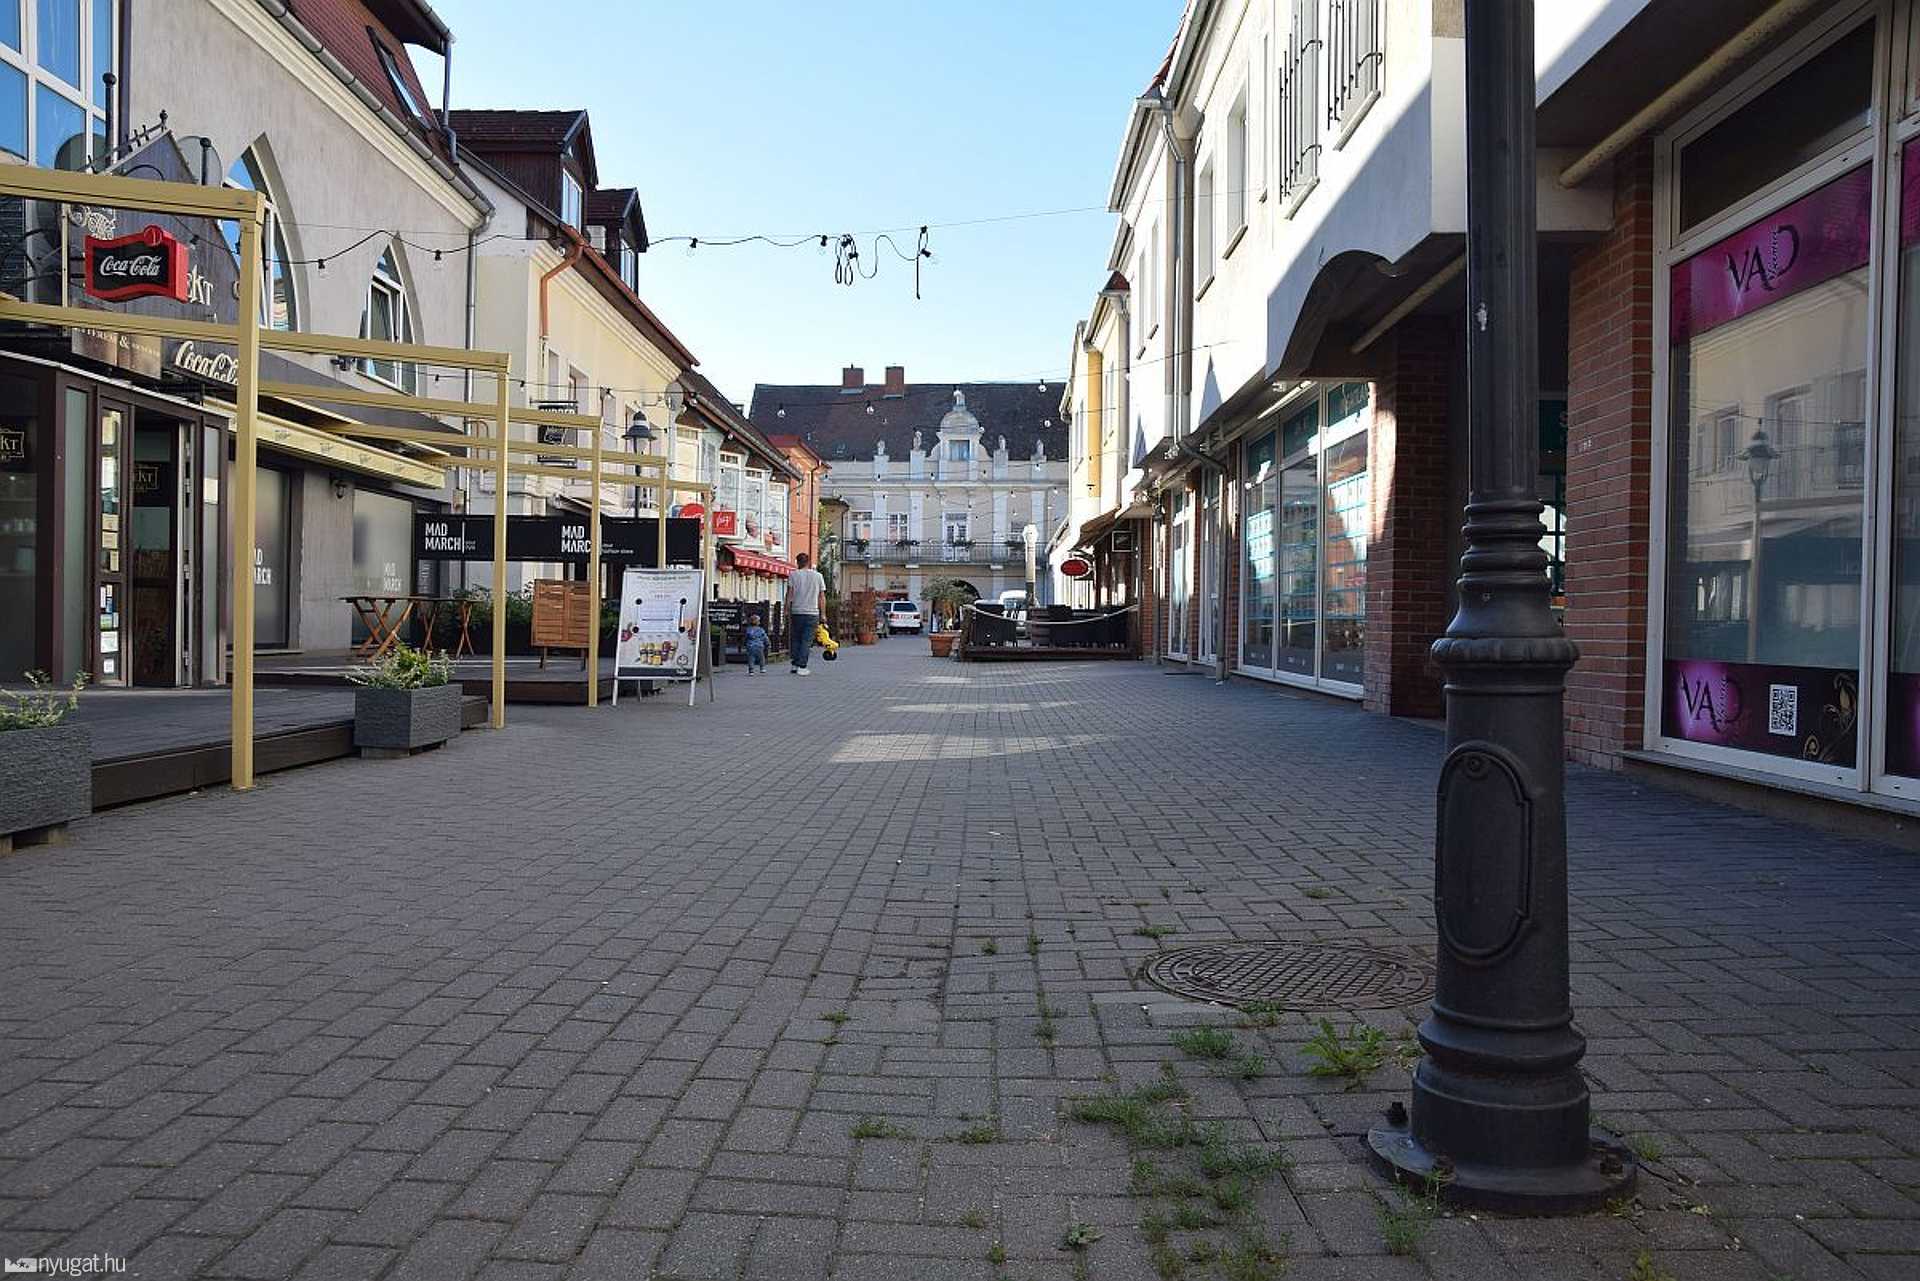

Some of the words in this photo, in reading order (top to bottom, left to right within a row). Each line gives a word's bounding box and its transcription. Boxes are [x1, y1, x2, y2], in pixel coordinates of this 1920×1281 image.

[100, 255, 162, 276] Coca-Cola
[425, 522, 448, 537] MAD
[561, 525, 585, 540] MAD
[425, 537, 462, 551] MARCH
[561, 540, 592, 554] MARC
